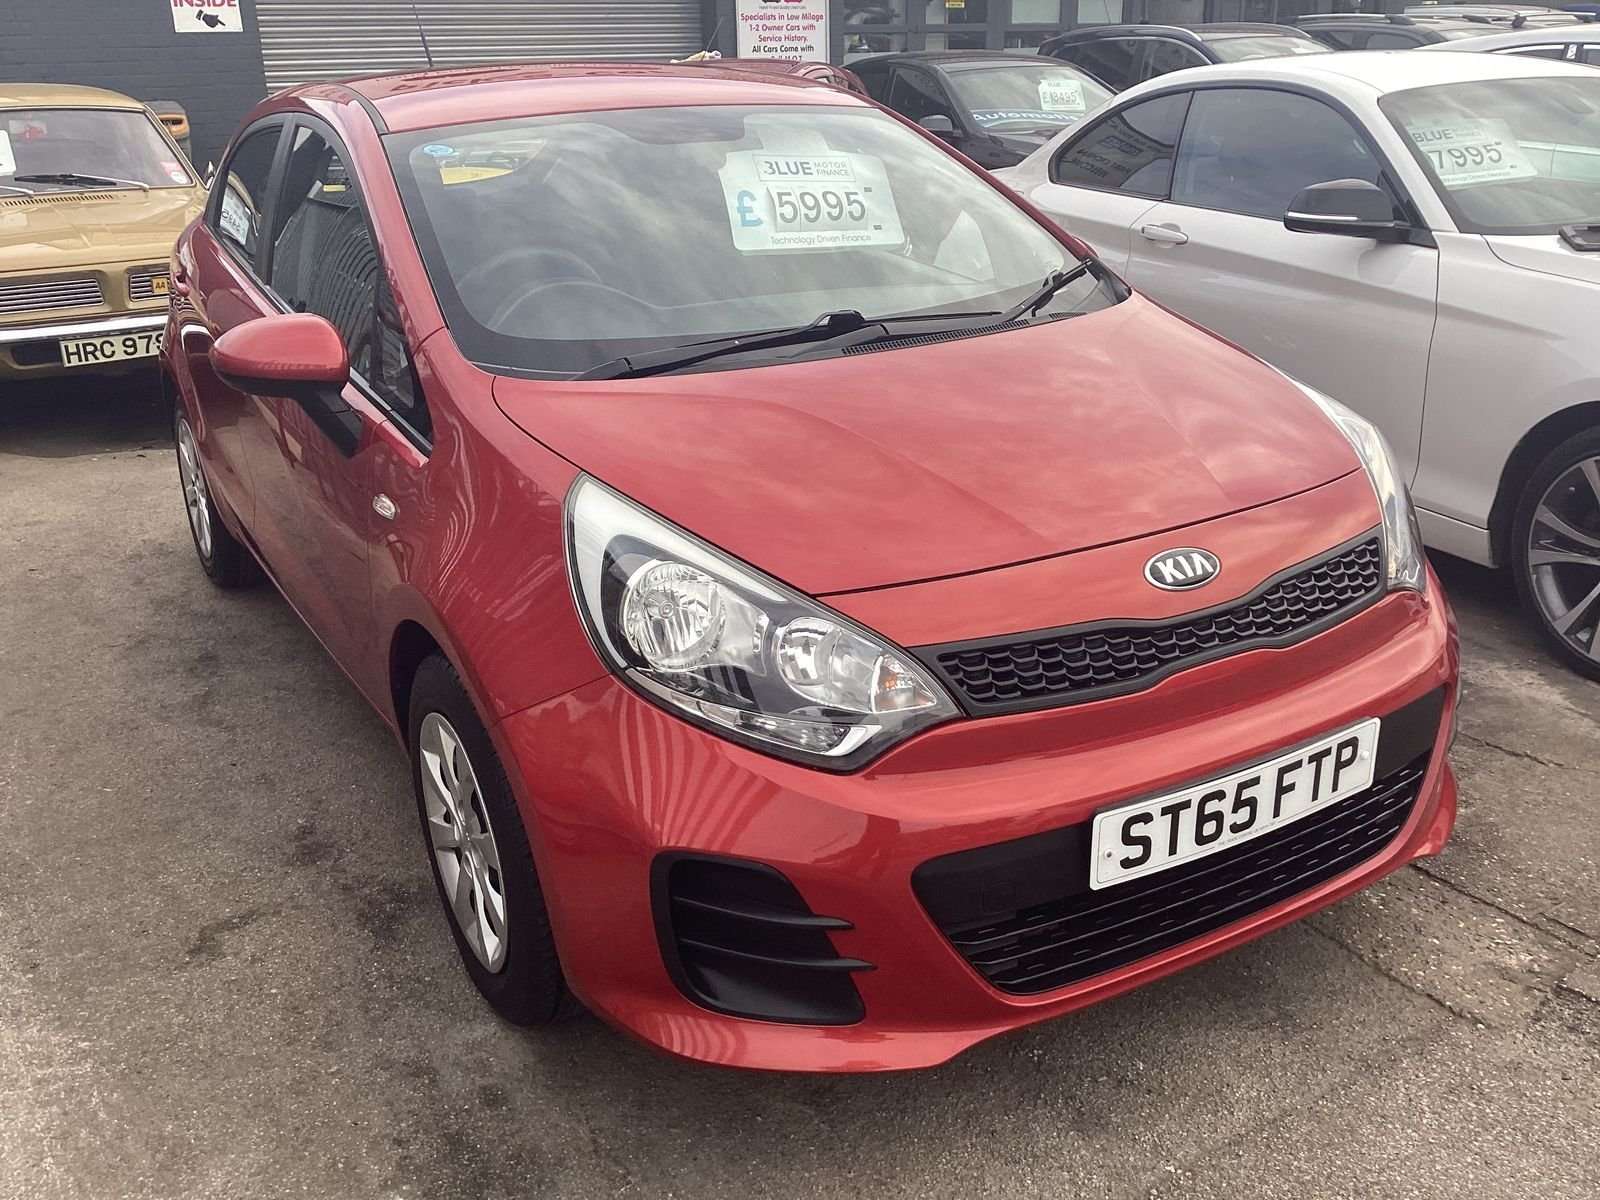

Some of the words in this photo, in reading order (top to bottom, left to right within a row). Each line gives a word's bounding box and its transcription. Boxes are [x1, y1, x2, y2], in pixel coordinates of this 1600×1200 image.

[740, 13, 777, 22] Specialists
[778, 12, 785, 20] in
[801, 13, 824, 22] Milage
[749, 24, 760, 32] 1-2
[784, 34, 808, 43] History.
[752, 45, 761, 53] All
[763, 45, 778, 53] Cars
[779, 45, 799, 53] Come
[800, 44, 814, 52] with
[1411, 128, 1454, 142] BLUE
[763, 160, 814, 176] BLUE
[770, 236, 815, 245] Technology
[816, 235, 840, 243] Driven
[841, 233, 872, 242] Finance
[155, 281, 165, 289] AA
[63, 340, 116, 365] HRC
[1154, 552, 1214, 583] KIA
[1119, 776, 1262, 870] ST65
[1272, 736, 1360, 819] FTP
